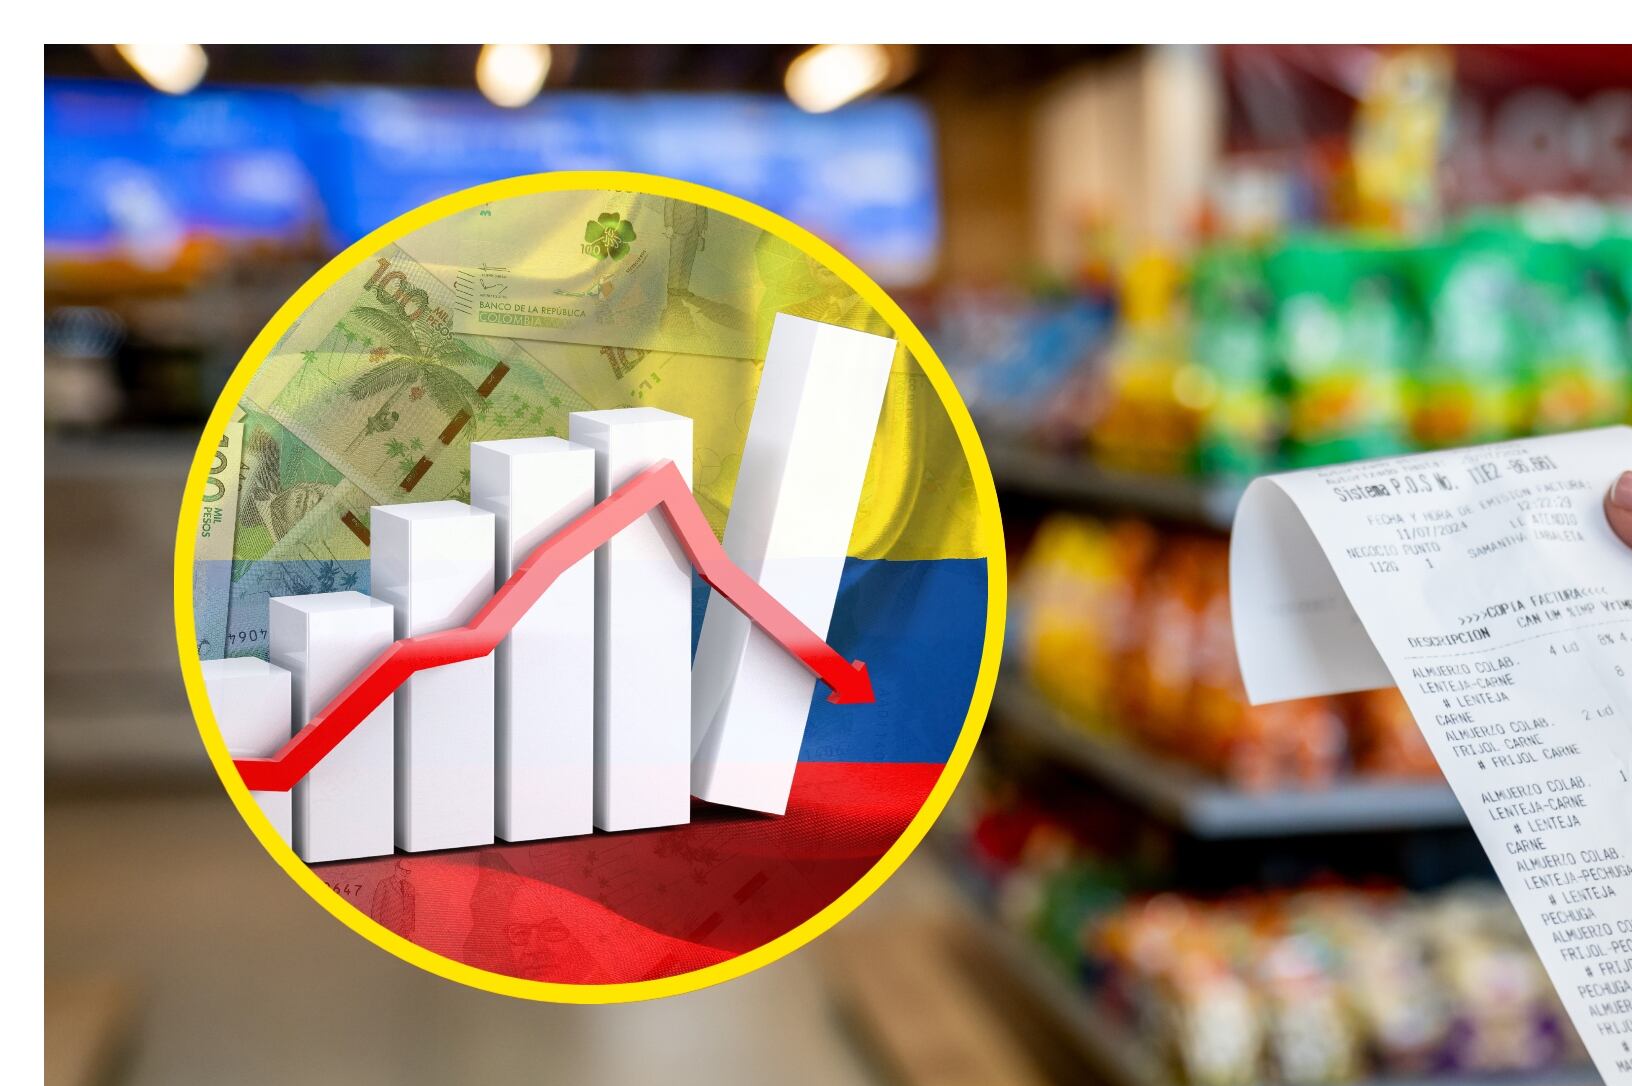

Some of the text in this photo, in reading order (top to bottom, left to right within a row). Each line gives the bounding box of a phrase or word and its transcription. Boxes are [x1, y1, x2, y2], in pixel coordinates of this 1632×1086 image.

[580, 242, 601, 256] 100
[363, 256, 431, 322] 100
[432, 307, 449, 323] MIL
[478, 300, 586, 317] BANCO DE LA REPÚBLICA
[1334, 481, 1391, 502] Sistema
[1392, 474, 1434, 495] P.O.S
[201, 506, 212, 538] PESOS
[212, 507, 223, 524] MIL
[1367, 512, 1403, 526] FECHA
[1409, 512, 1418, 523] Y
[1423, 508, 1454, 523] HORA
[1458, 505, 1473, 518] DE
[1396, 520, 1470, 541] 11/07/2024
[1347, 541, 1442, 559] NEGOCIO PUNTO
[1467, 532, 1529, 559] SAMANTHA
[1407, 626, 1492, 649] DESCRIPCION
[1516, 613, 1542, 629] CAN
[1549, 644, 1558, 657] 4
[1412, 655, 1522, 679] ALMUERZO COLAB.
[1419, 673, 1516, 695] LENTEJA-CARNE
[1456, 691, 1512, 709] LENTEJA
[1435, 711, 1476, 727] CARNE
[1581, 708, 1594, 721] 2
[1445, 717, 1556, 743] ALMUERZO COLAB.
[1452, 740, 1502, 758] FRIJOL
[1504, 733, 1545, 750] CARNE
[1491, 751, 1541, 769] FRIJOL
[1542, 743, 1583, 761] CARNE
[1619, 769, 1629, 783] 1
[1481, 775, 1593, 805] ALMUERZO COLAB.
[1488, 793, 1589, 822] LENTEJA-CARNE
[1526, 815, 1583, 836] LENTEJA
[1505, 836, 1548, 855] CARNE
[1516, 846, 1627, 873] ALMUERZO COLAB.
[1561, 885, 1617, 906] LENTEJA
[1540, 907, 1598, 926] PECHUGA
[1551, 923, 1614, 944] ALMUERZO
